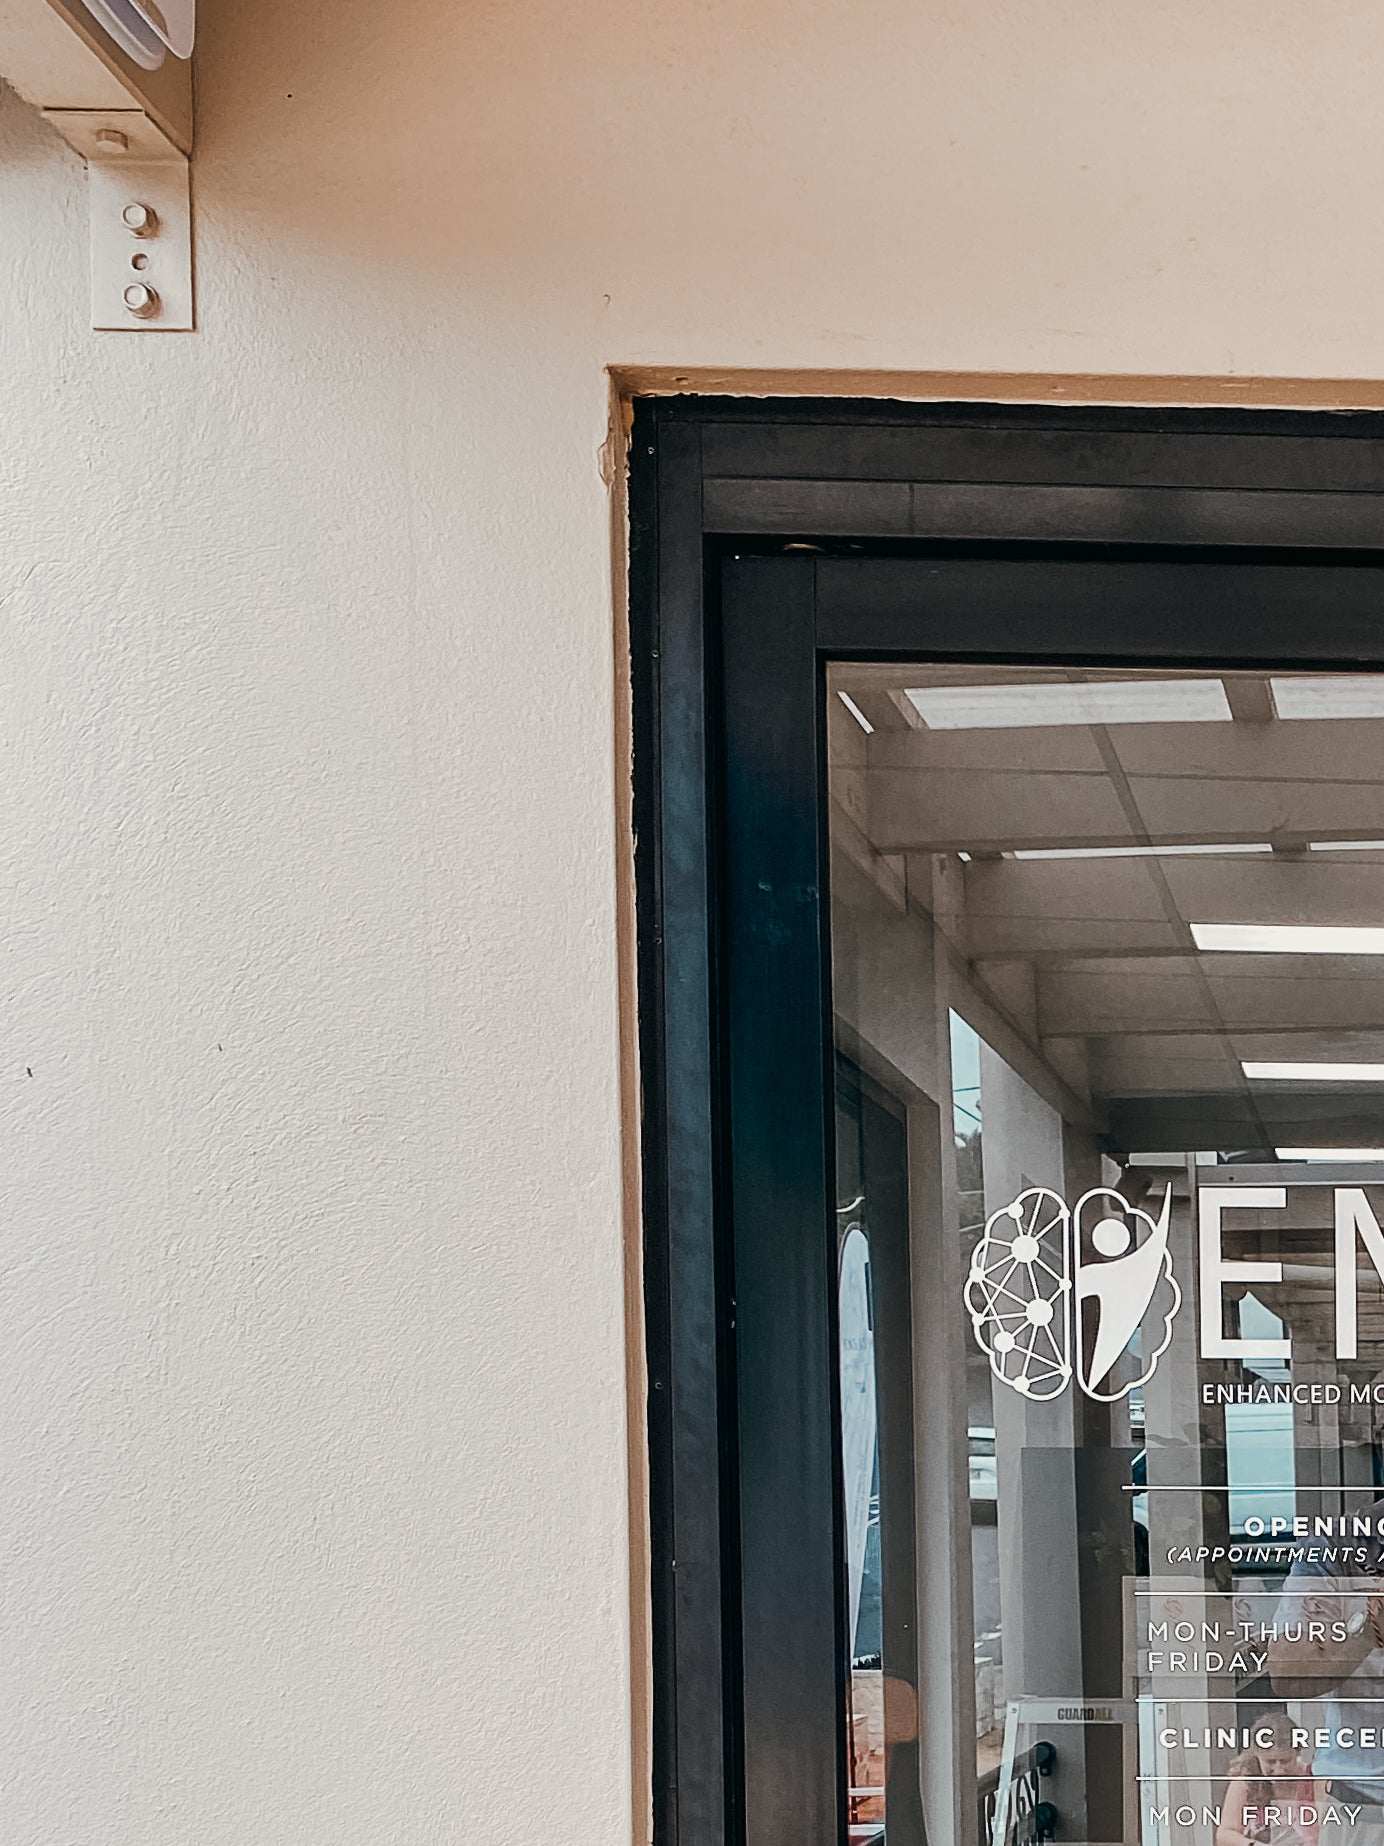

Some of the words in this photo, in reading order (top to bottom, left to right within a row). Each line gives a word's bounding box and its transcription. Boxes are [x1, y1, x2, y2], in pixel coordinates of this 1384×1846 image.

[1201, 1383, 1342, 1406] ENHANCED
[1166, 1546, 1369, 1564] (APPOINTMENTS
[1147, 1622, 1348, 1643] MON-THURS
[1147, 1652, 1269, 1673] FRIDAY
[1159, 1727, 1275, 1749] CLINIC
[1149, 1805, 1222, 1826] MON
[1242, 1805, 1363, 1826] FRIDAY
